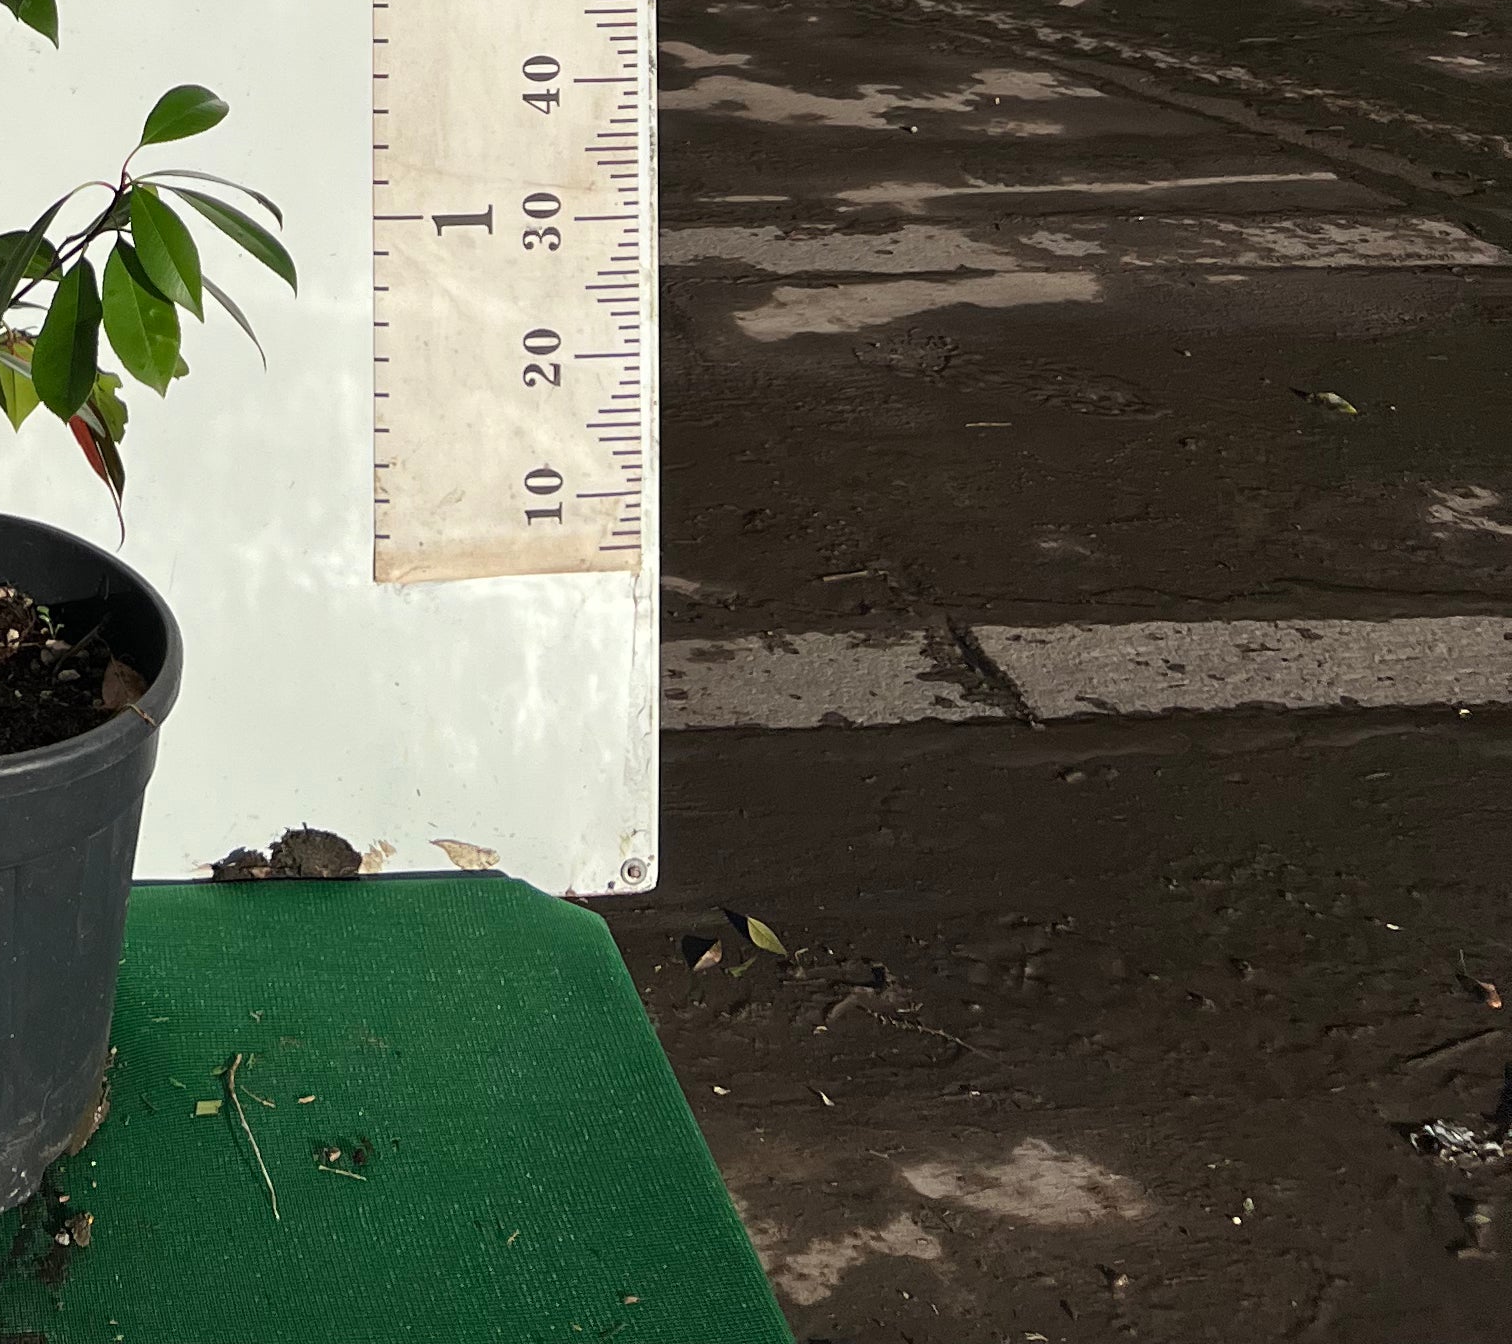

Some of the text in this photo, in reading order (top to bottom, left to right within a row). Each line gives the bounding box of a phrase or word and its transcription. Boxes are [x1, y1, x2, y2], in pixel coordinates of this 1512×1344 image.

[522, 56, 560, 115] 40
[431, 204, 493, 237] 1
[522, 193, 561, 251] 30
[523, 329, 561, 387] 20
[524, 467, 563, 525] 10
